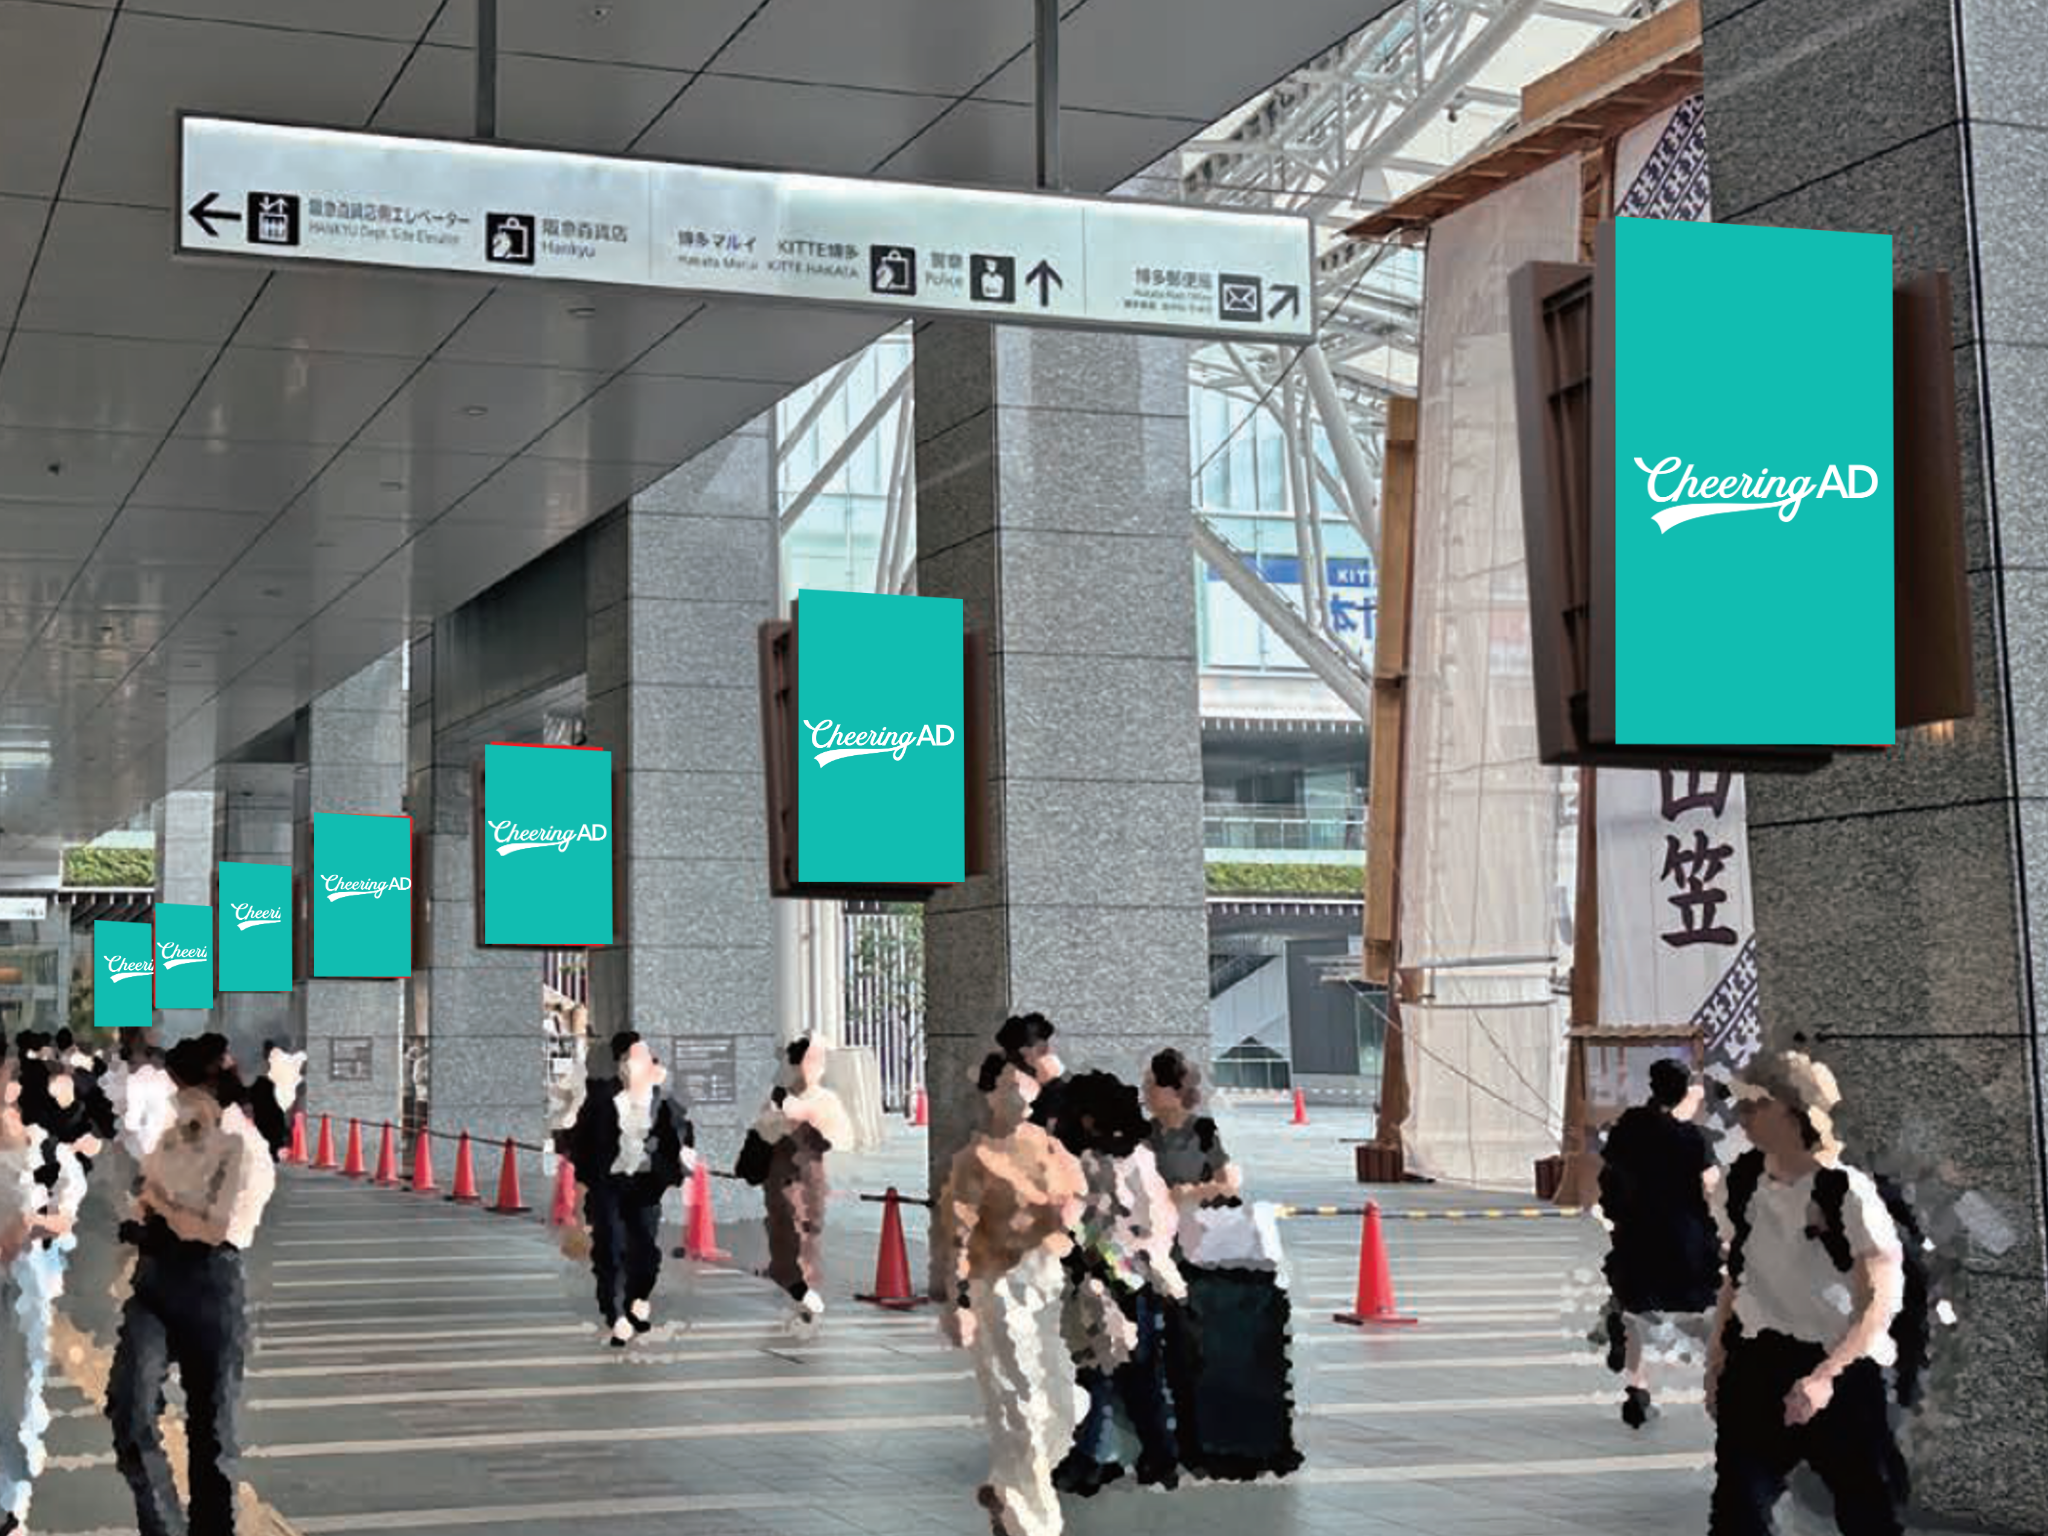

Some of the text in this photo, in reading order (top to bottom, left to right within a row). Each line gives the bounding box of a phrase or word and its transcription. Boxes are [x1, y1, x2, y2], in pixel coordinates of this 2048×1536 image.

[543, 240, 596, 259] Hankyu
[678, 230, 757, 253] 博多マルイ
[777, 240, 860, 261] KITTE博多
